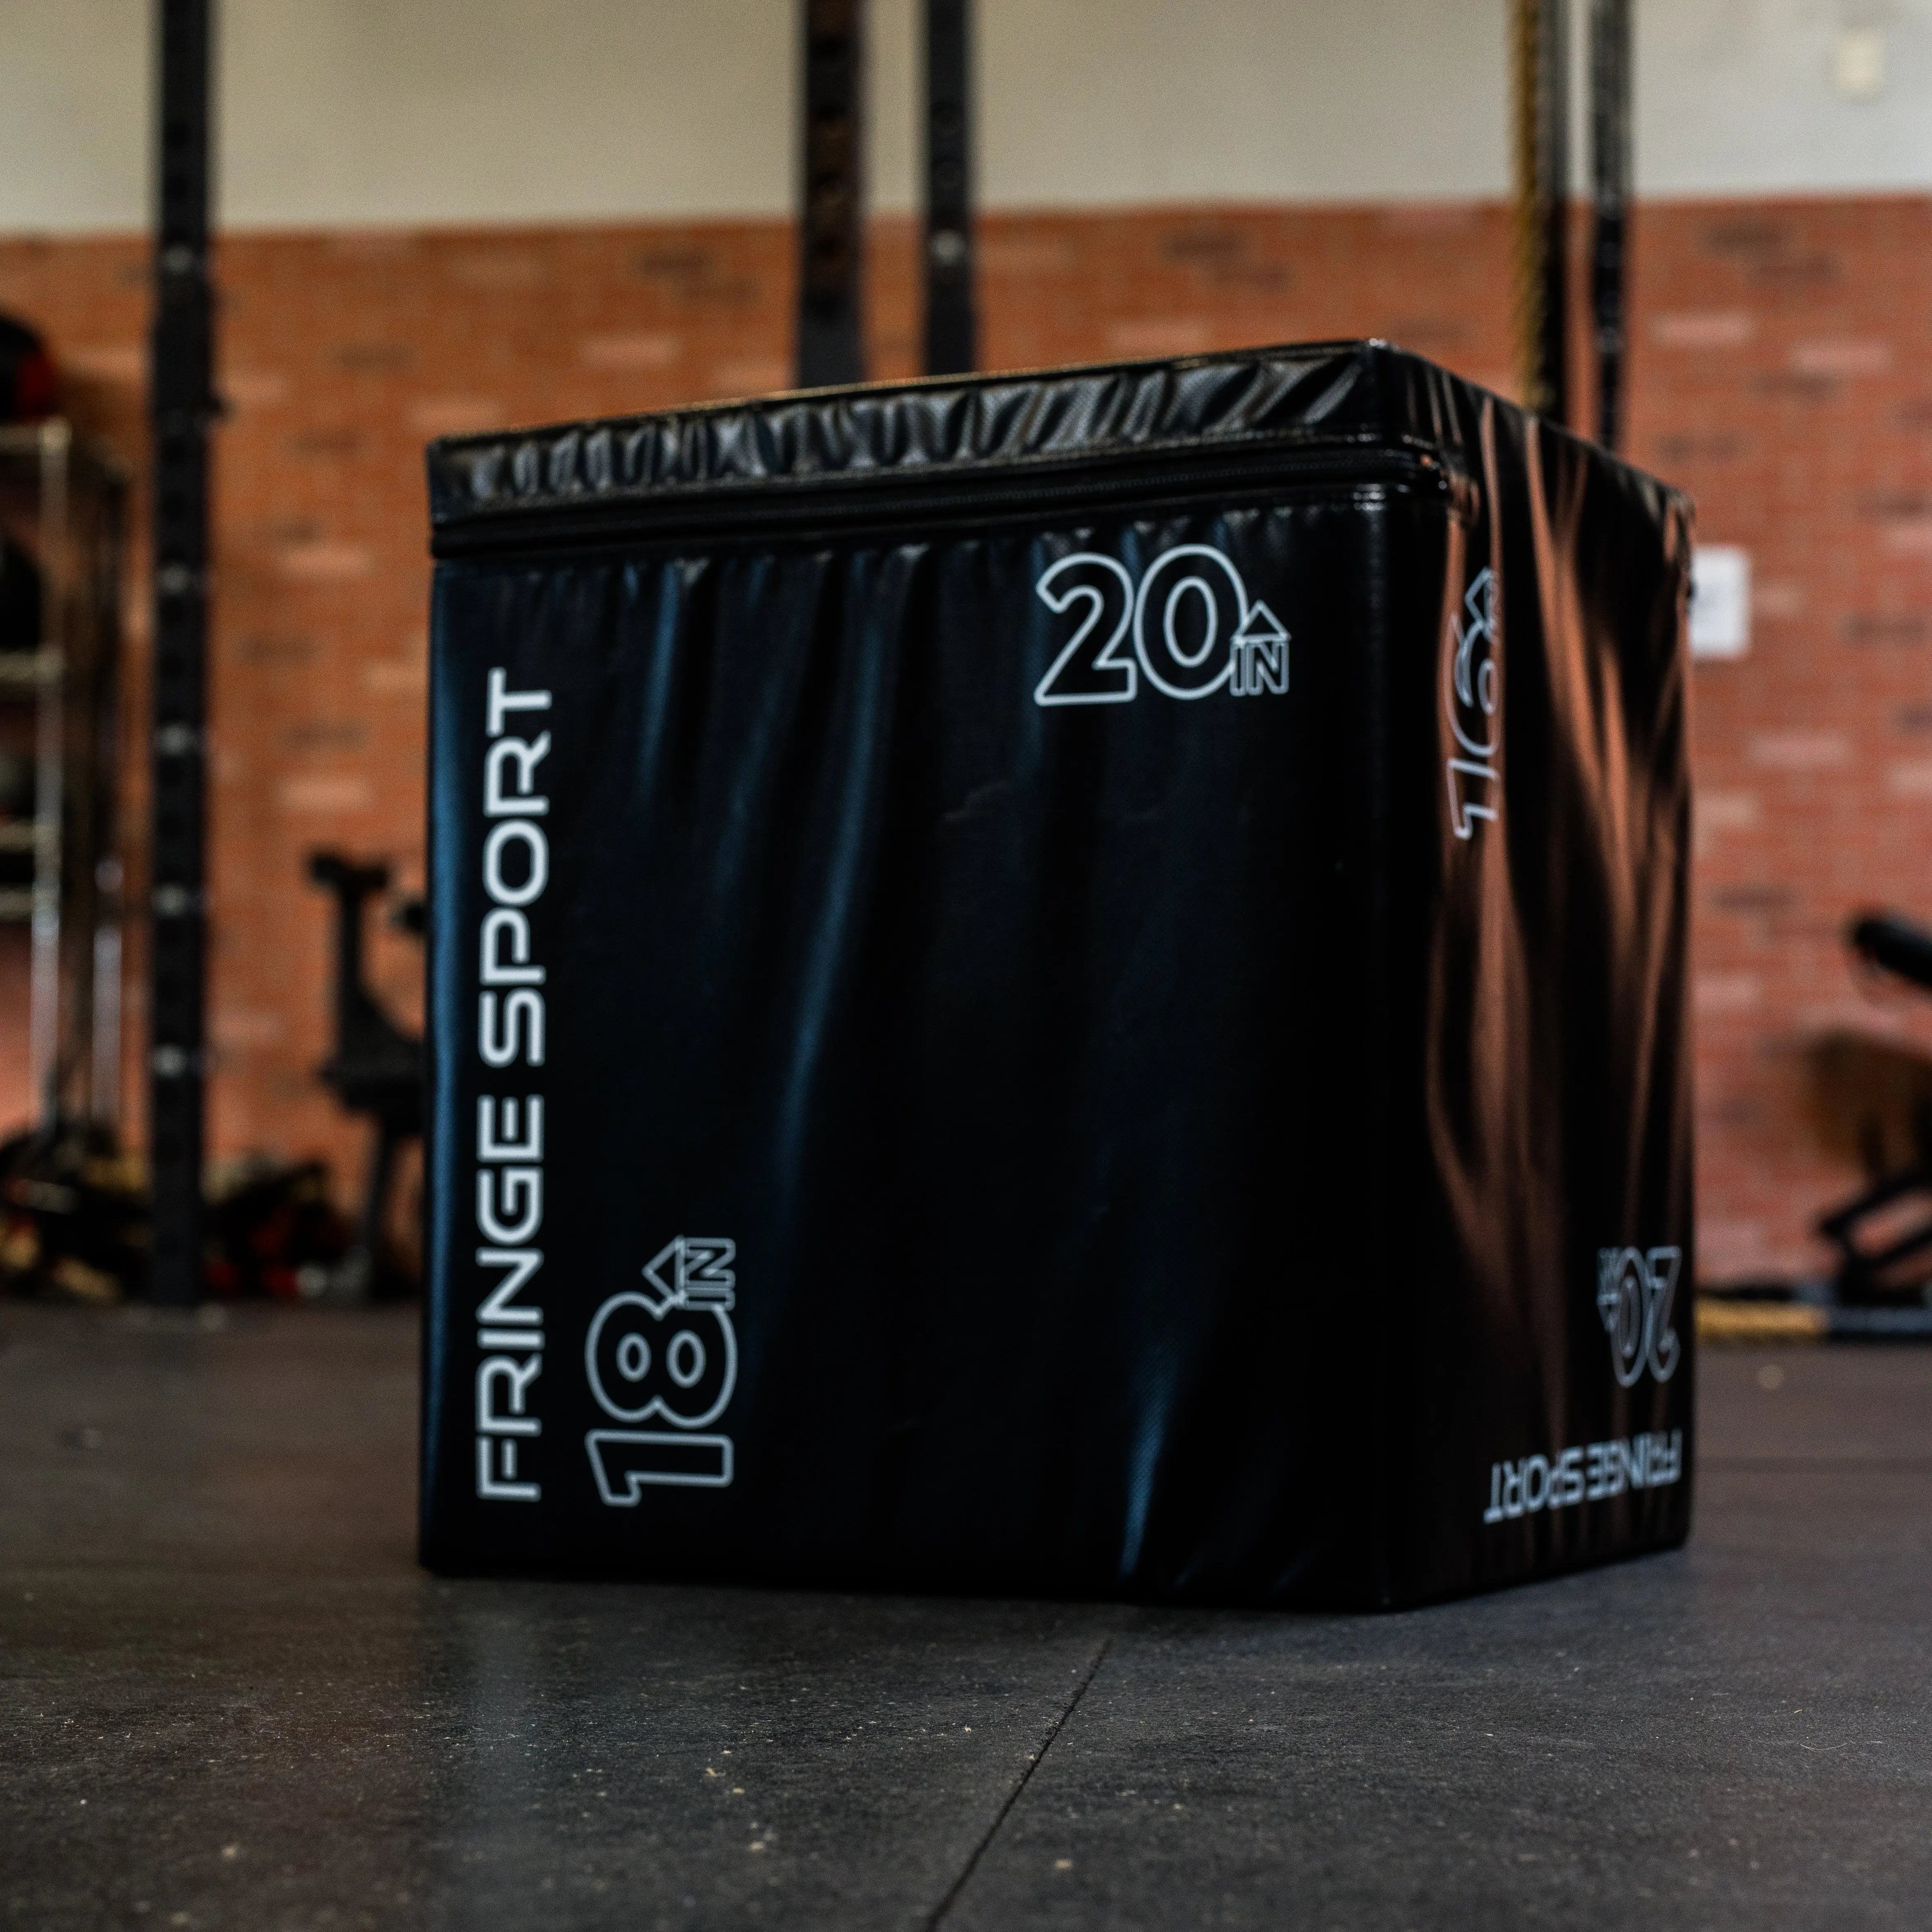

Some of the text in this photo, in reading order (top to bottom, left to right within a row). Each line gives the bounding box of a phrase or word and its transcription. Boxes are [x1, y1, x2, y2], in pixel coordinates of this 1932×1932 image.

[476, 667, 552, 1502] FRINGE SPORT
[1483, 1445, 1585, 1525] SPORT
